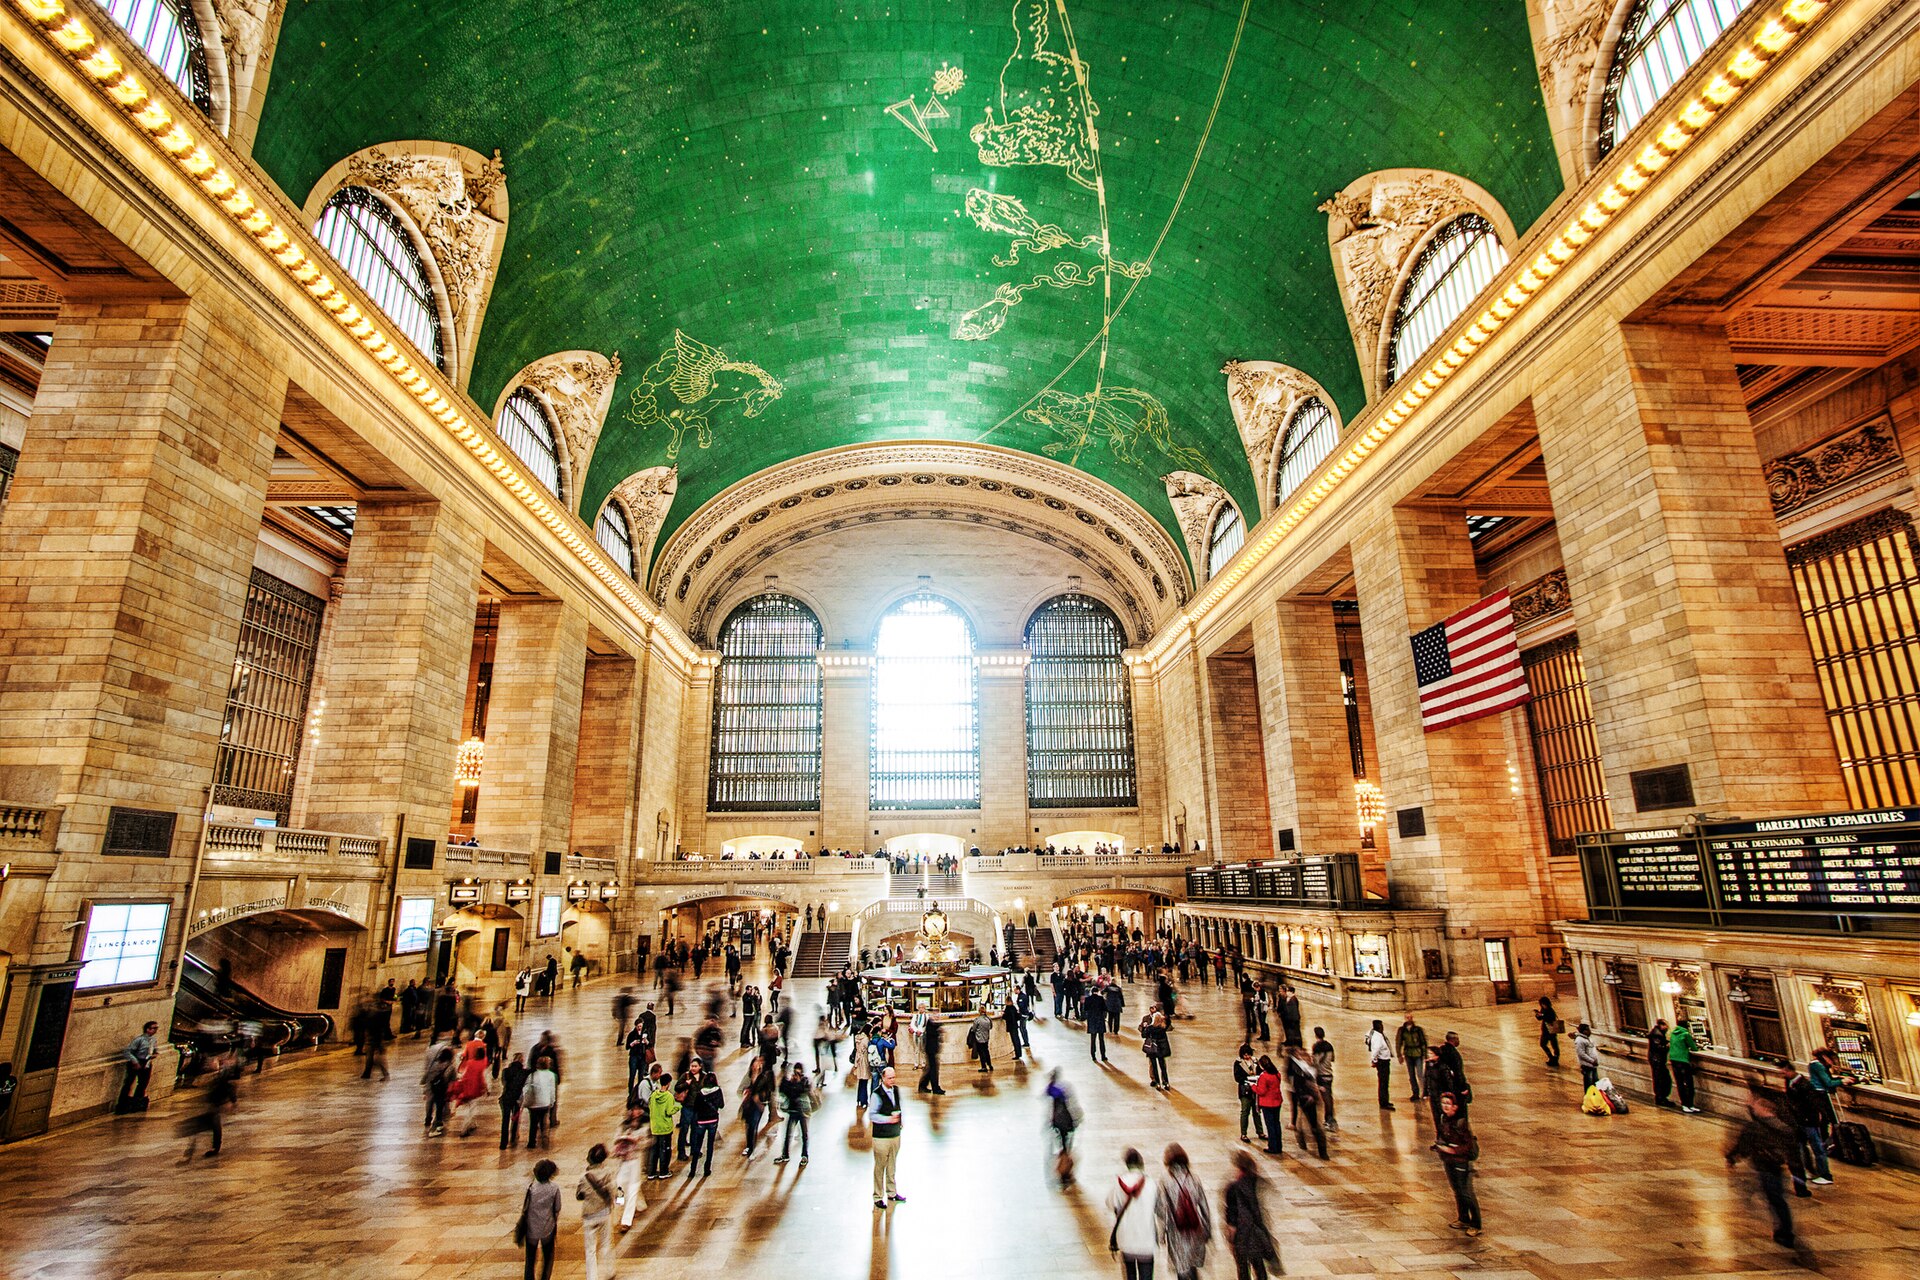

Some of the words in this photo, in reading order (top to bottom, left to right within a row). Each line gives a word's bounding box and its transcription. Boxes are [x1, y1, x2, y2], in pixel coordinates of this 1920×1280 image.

[1756, 819, 1800, 832] HARLEM
[1801, 817, 1827, 829] LINE
[1829, 811, 1906, 827] DEPARTURES
[1625, 829, 1678, 840] INFORMATION
[1752, 838, 1804, 848] DESTINATION
[1815, 835, 1858, 844] REMARKS
[1780, 849, 1803, 858] PLAINS
[1820, 848, 1850, 856] FORDHAM
[1876, 846, 1896, 854] STOP
[1846, 859, 1873, 867] PLAINS
[1884, 858, 1899, 866] 1ST
[1902, 858, 1920, 866] STOP
[1882, 870, 1903, 878] STOP
[1069, 885, 1100, 895] LEXINGTON
[1828, 883, 1859, 891] MELROSE
[1869, 883, 1883, 891] 1ST
[1886, 883, 1906, 891] STOP
[740, 889, 770, 898] LEXINGTON
[1830, 895, 1874, 903] CONNECTION
[228, 904, 246, 917] LIFE
[247, 897, 286, 911] BUILDING
